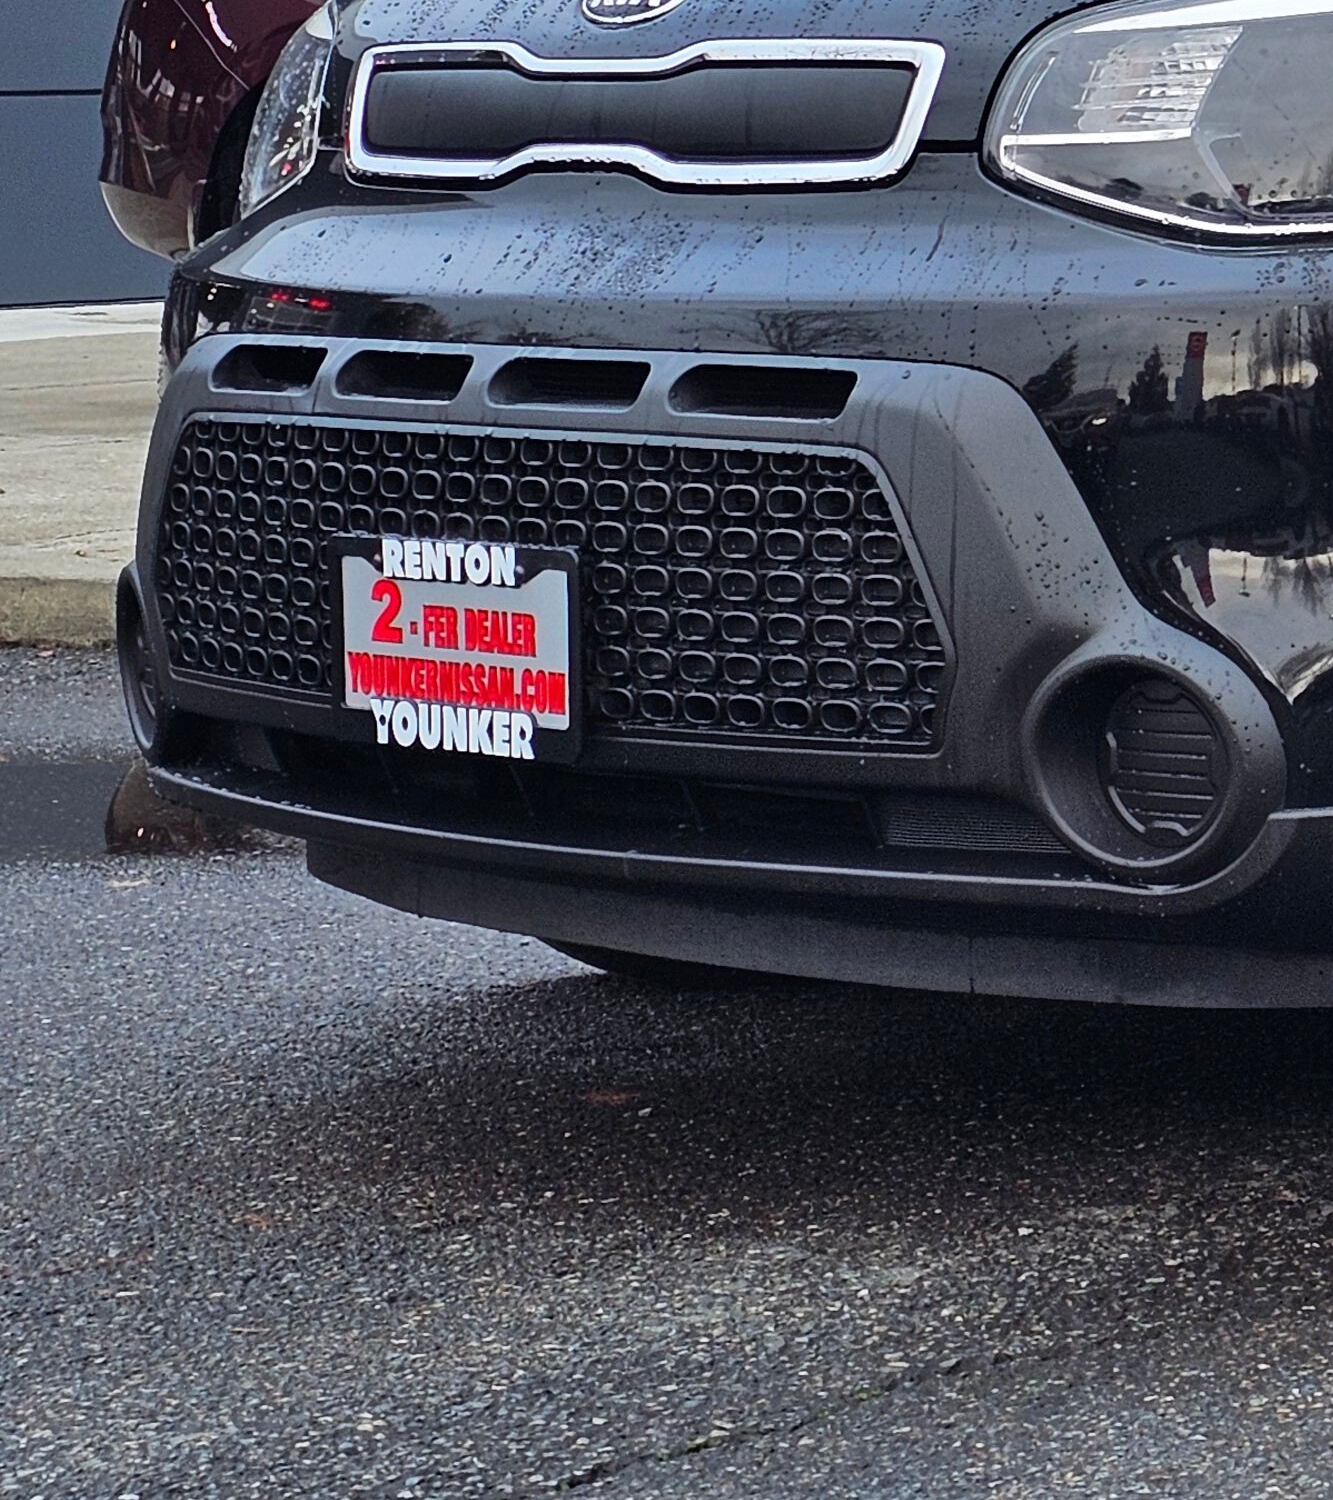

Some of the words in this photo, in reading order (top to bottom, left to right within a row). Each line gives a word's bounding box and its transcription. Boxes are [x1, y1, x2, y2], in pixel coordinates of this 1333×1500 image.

[381, 538, 516, 587] RENTON
[464, 607, 537, 658] DEALER
[347, 650, 566, 716] YOUNKERNISSAN.COM
[370, 697, 536, 761] YOUNKER
